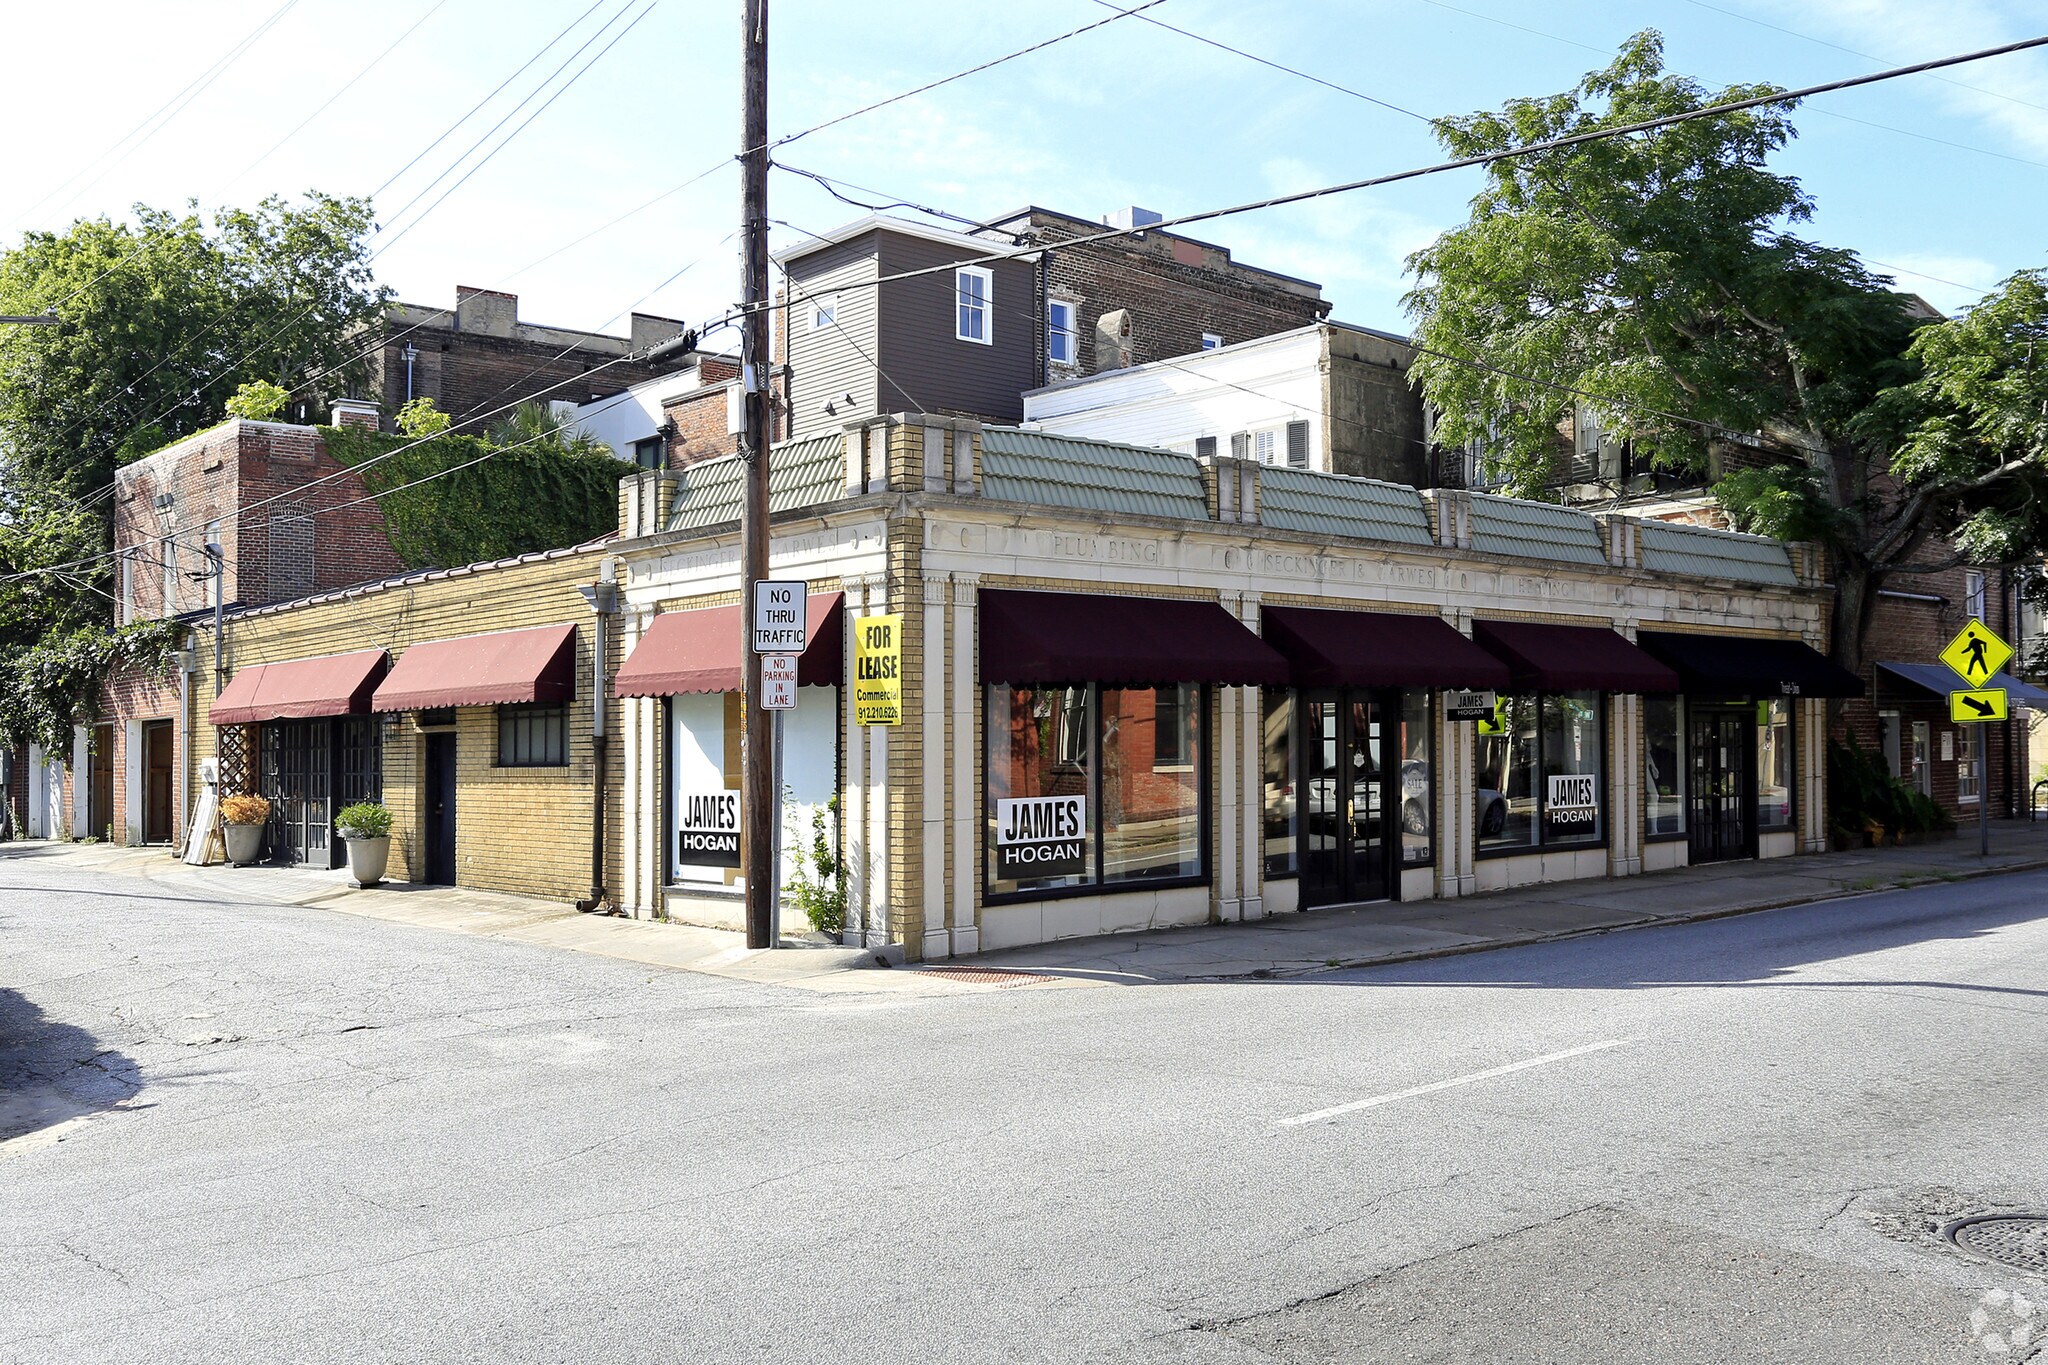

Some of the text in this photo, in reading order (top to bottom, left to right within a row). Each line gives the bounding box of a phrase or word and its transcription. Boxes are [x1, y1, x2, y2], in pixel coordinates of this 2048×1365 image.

[1266, 554, 1346, 577] SECKINGER
[1357, 563, 1366, 579] &
[770, 589, 791, 604] NO
[766, 610, 796, 624] THRU
[756, 629, 804, 643] TRAFFIC
[866, 625, 891, 649] FOR
[773, 659, 786, 669] NO
[858, 655, 898, 680] LEASE
[764, 671, 795, 681] PARKING
[775, 683, 783, 693] IN
[857, 688, 899, 701] Commercial
[769, 695, 789, 705] LANE
[1457, 695, 1484, 708] JAMES
[1457, 708, 1484, 716] HOGAN
[1552, 778, 1592, 807] JAMES
[684, 795, 735, 830] JAMES
[1552, 810, 1593, 824] HOGAN
[1005, 800, 1079, 841] JAMES
[683, 834, 737, 852] HOGAN
[1005, 843, 1080, 865] HOGAN
